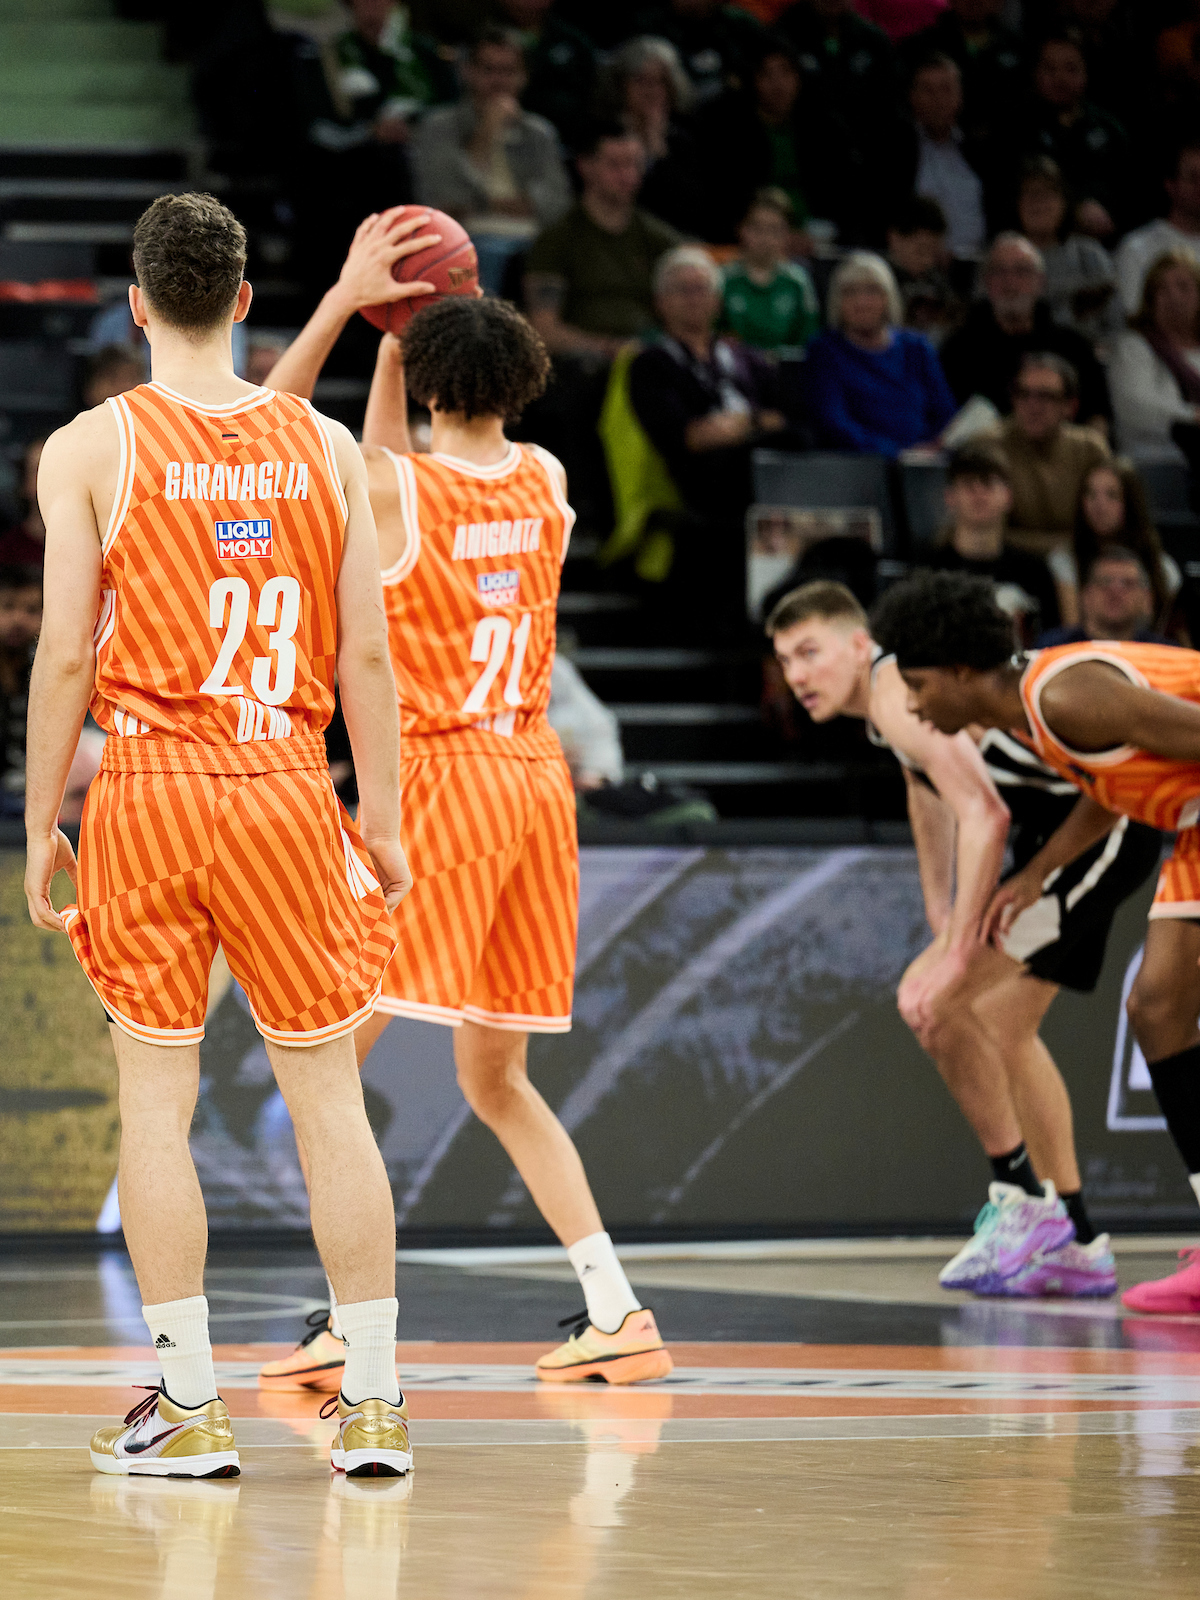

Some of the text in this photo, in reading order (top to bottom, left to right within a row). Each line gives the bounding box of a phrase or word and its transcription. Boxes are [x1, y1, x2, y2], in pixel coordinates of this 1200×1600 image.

[164, 461, 308, 501] GARAVAGLIA
[217, 521, 269, 540] LIQUI
[218, 539, 271, 557] MOLY
[478, 571, 518, 591] LIQUI
[199, 575, 301, 706] 23
[461, 612, 532, 713] 21
